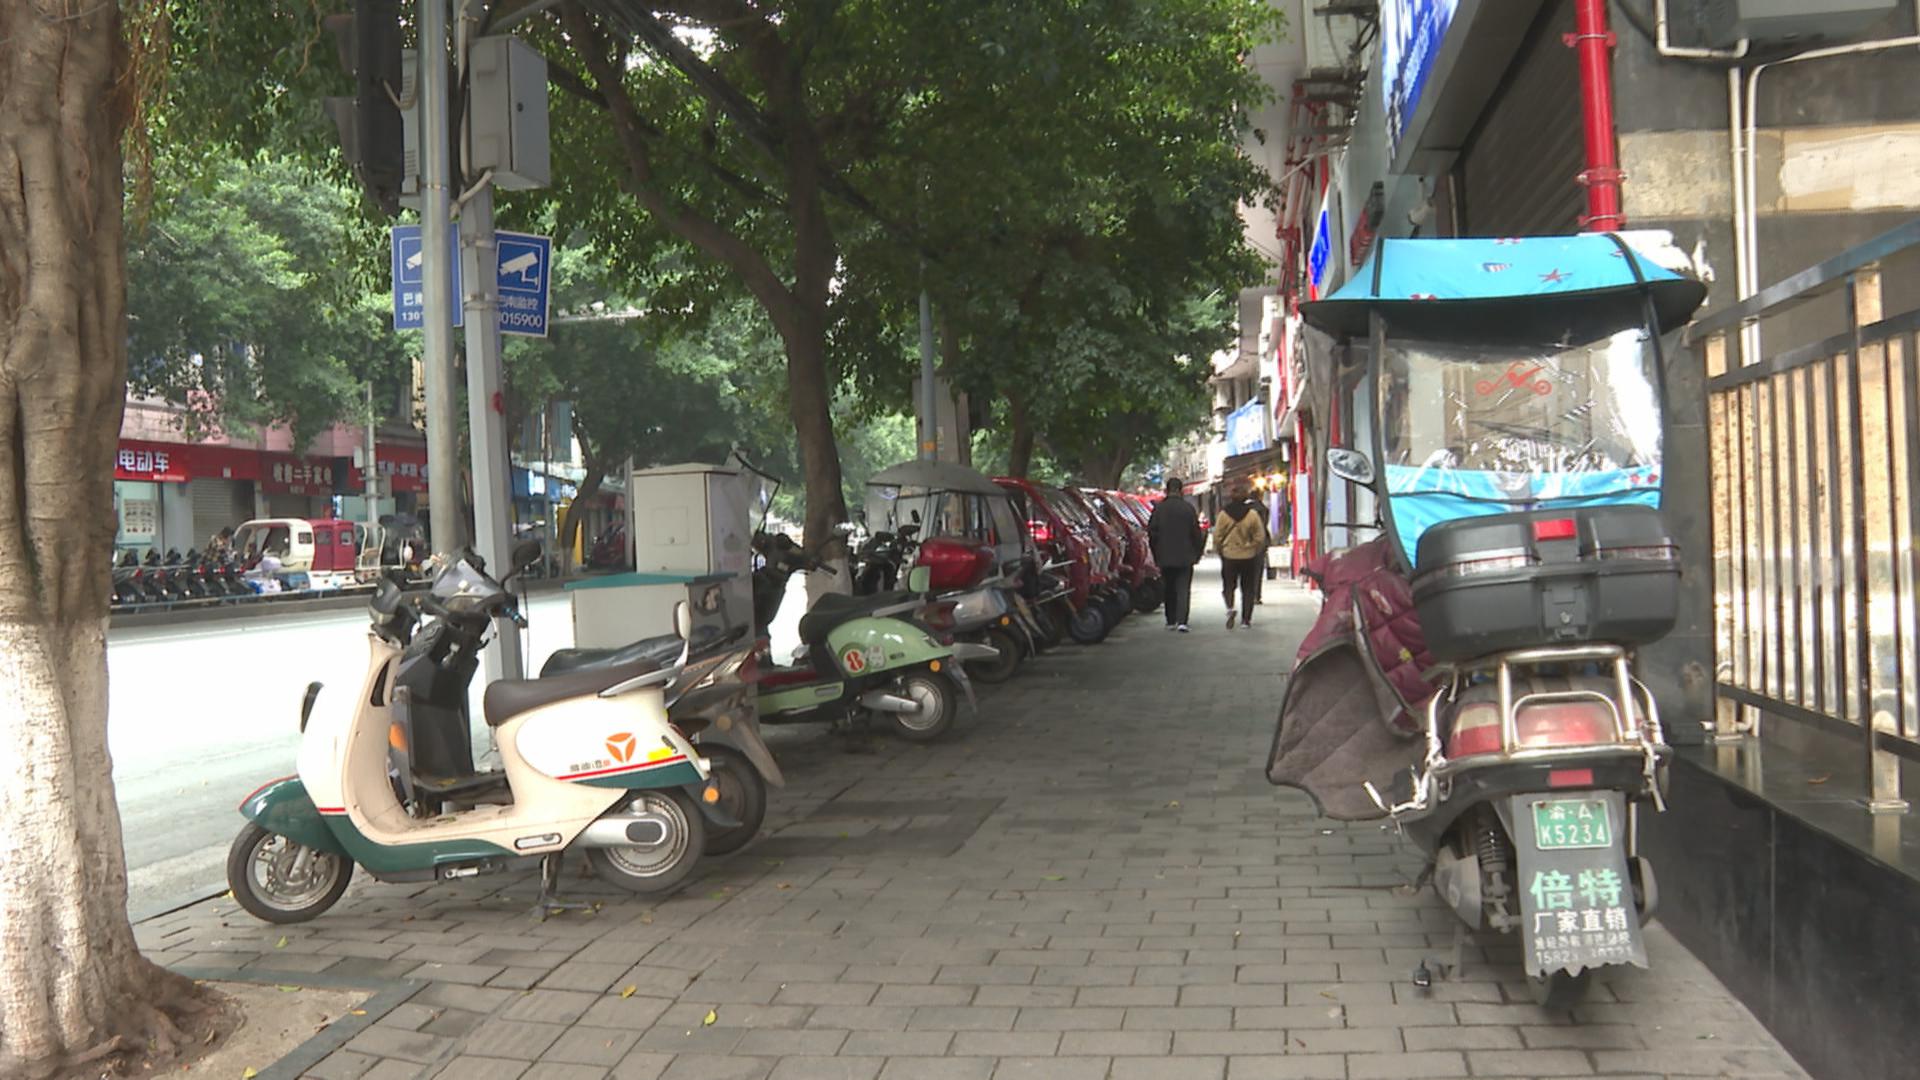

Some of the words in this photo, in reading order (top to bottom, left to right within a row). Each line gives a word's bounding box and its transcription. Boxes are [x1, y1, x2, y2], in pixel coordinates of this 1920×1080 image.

[401, 311, 424, 321] 130
[499, 311, 543, 328] 015900
[114, 449, 169, 472] 电动车
[1540, 822, 1606, 844] K5234
[1529, 868, 1622, 910] 倍特
[1533, 907, 1628, 934] 厂家直销
